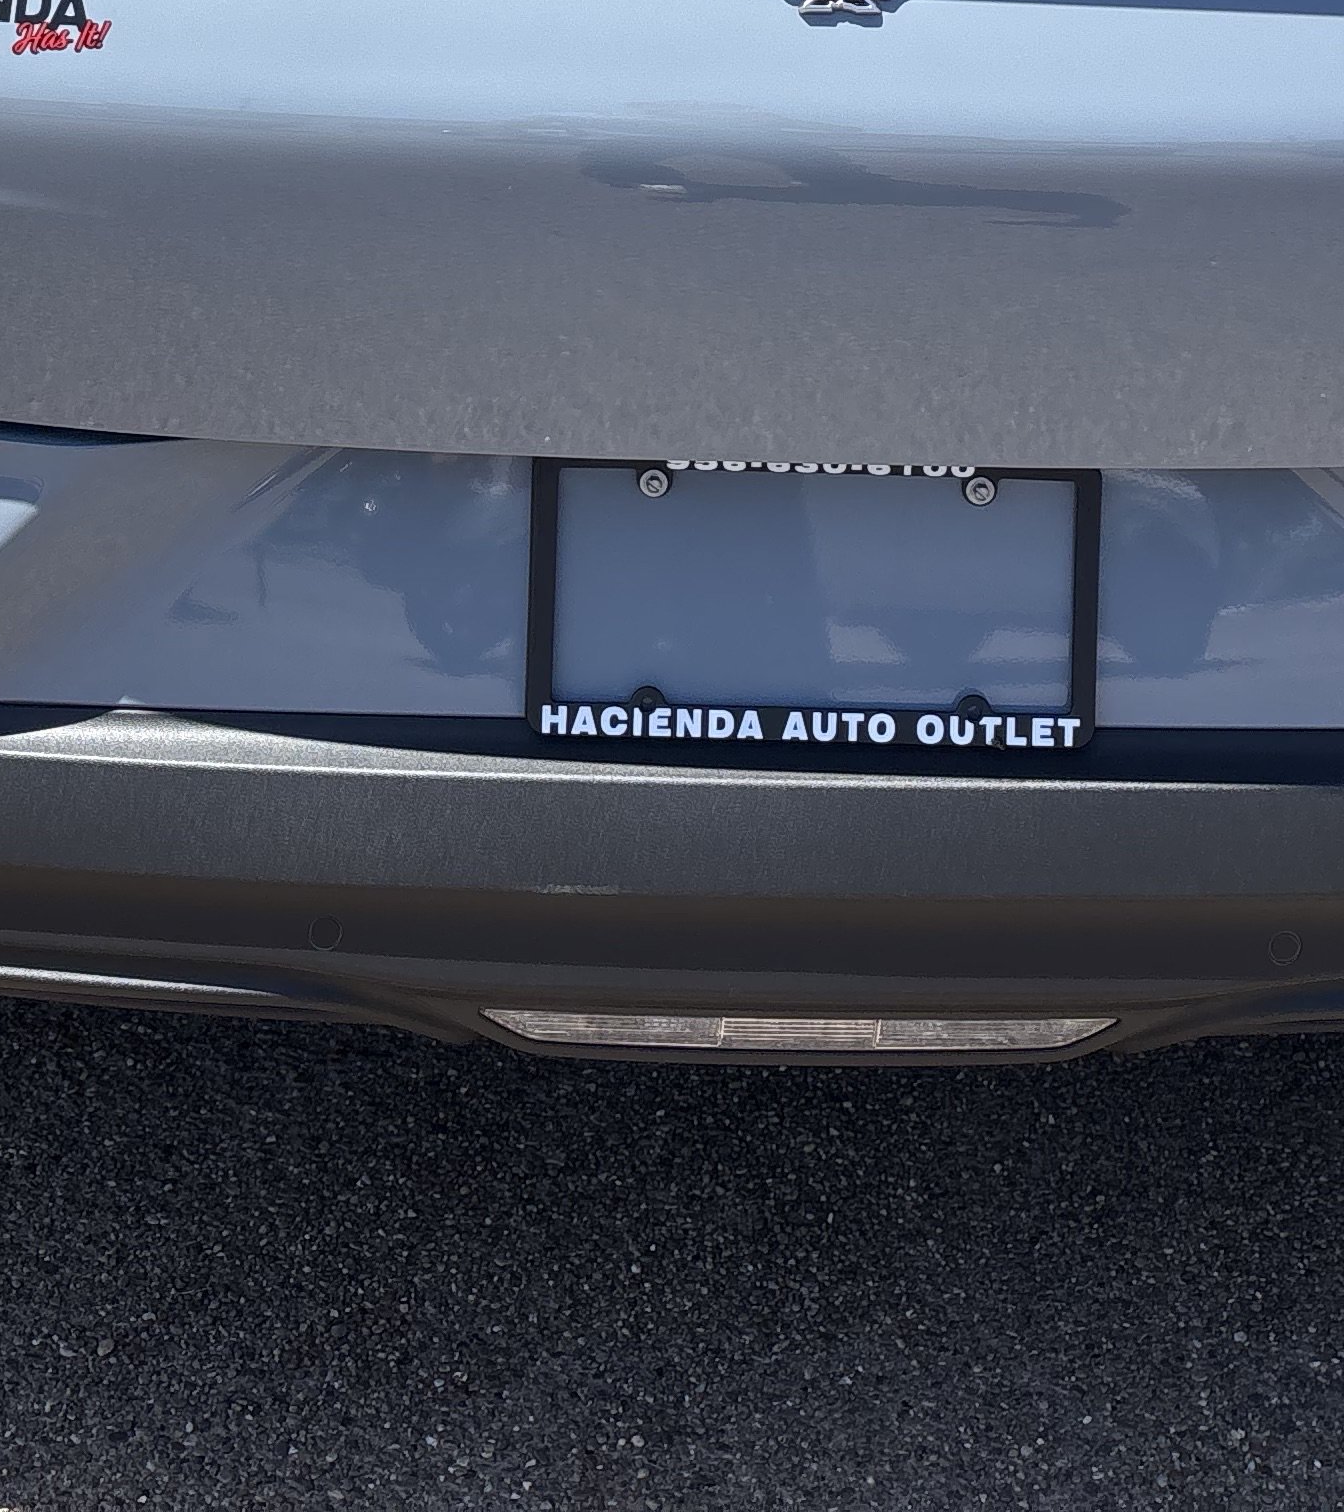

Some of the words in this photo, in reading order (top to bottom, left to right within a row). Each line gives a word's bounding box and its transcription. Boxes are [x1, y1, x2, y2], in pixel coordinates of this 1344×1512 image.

[12, 21, 73, 55] Has
[74, 20, 112, 54] It!
[541, 705, 763, 740] HACIENDA
[781, 711, 896, 743] AUTO
[916, 715, 1081, 748] OUTLET
